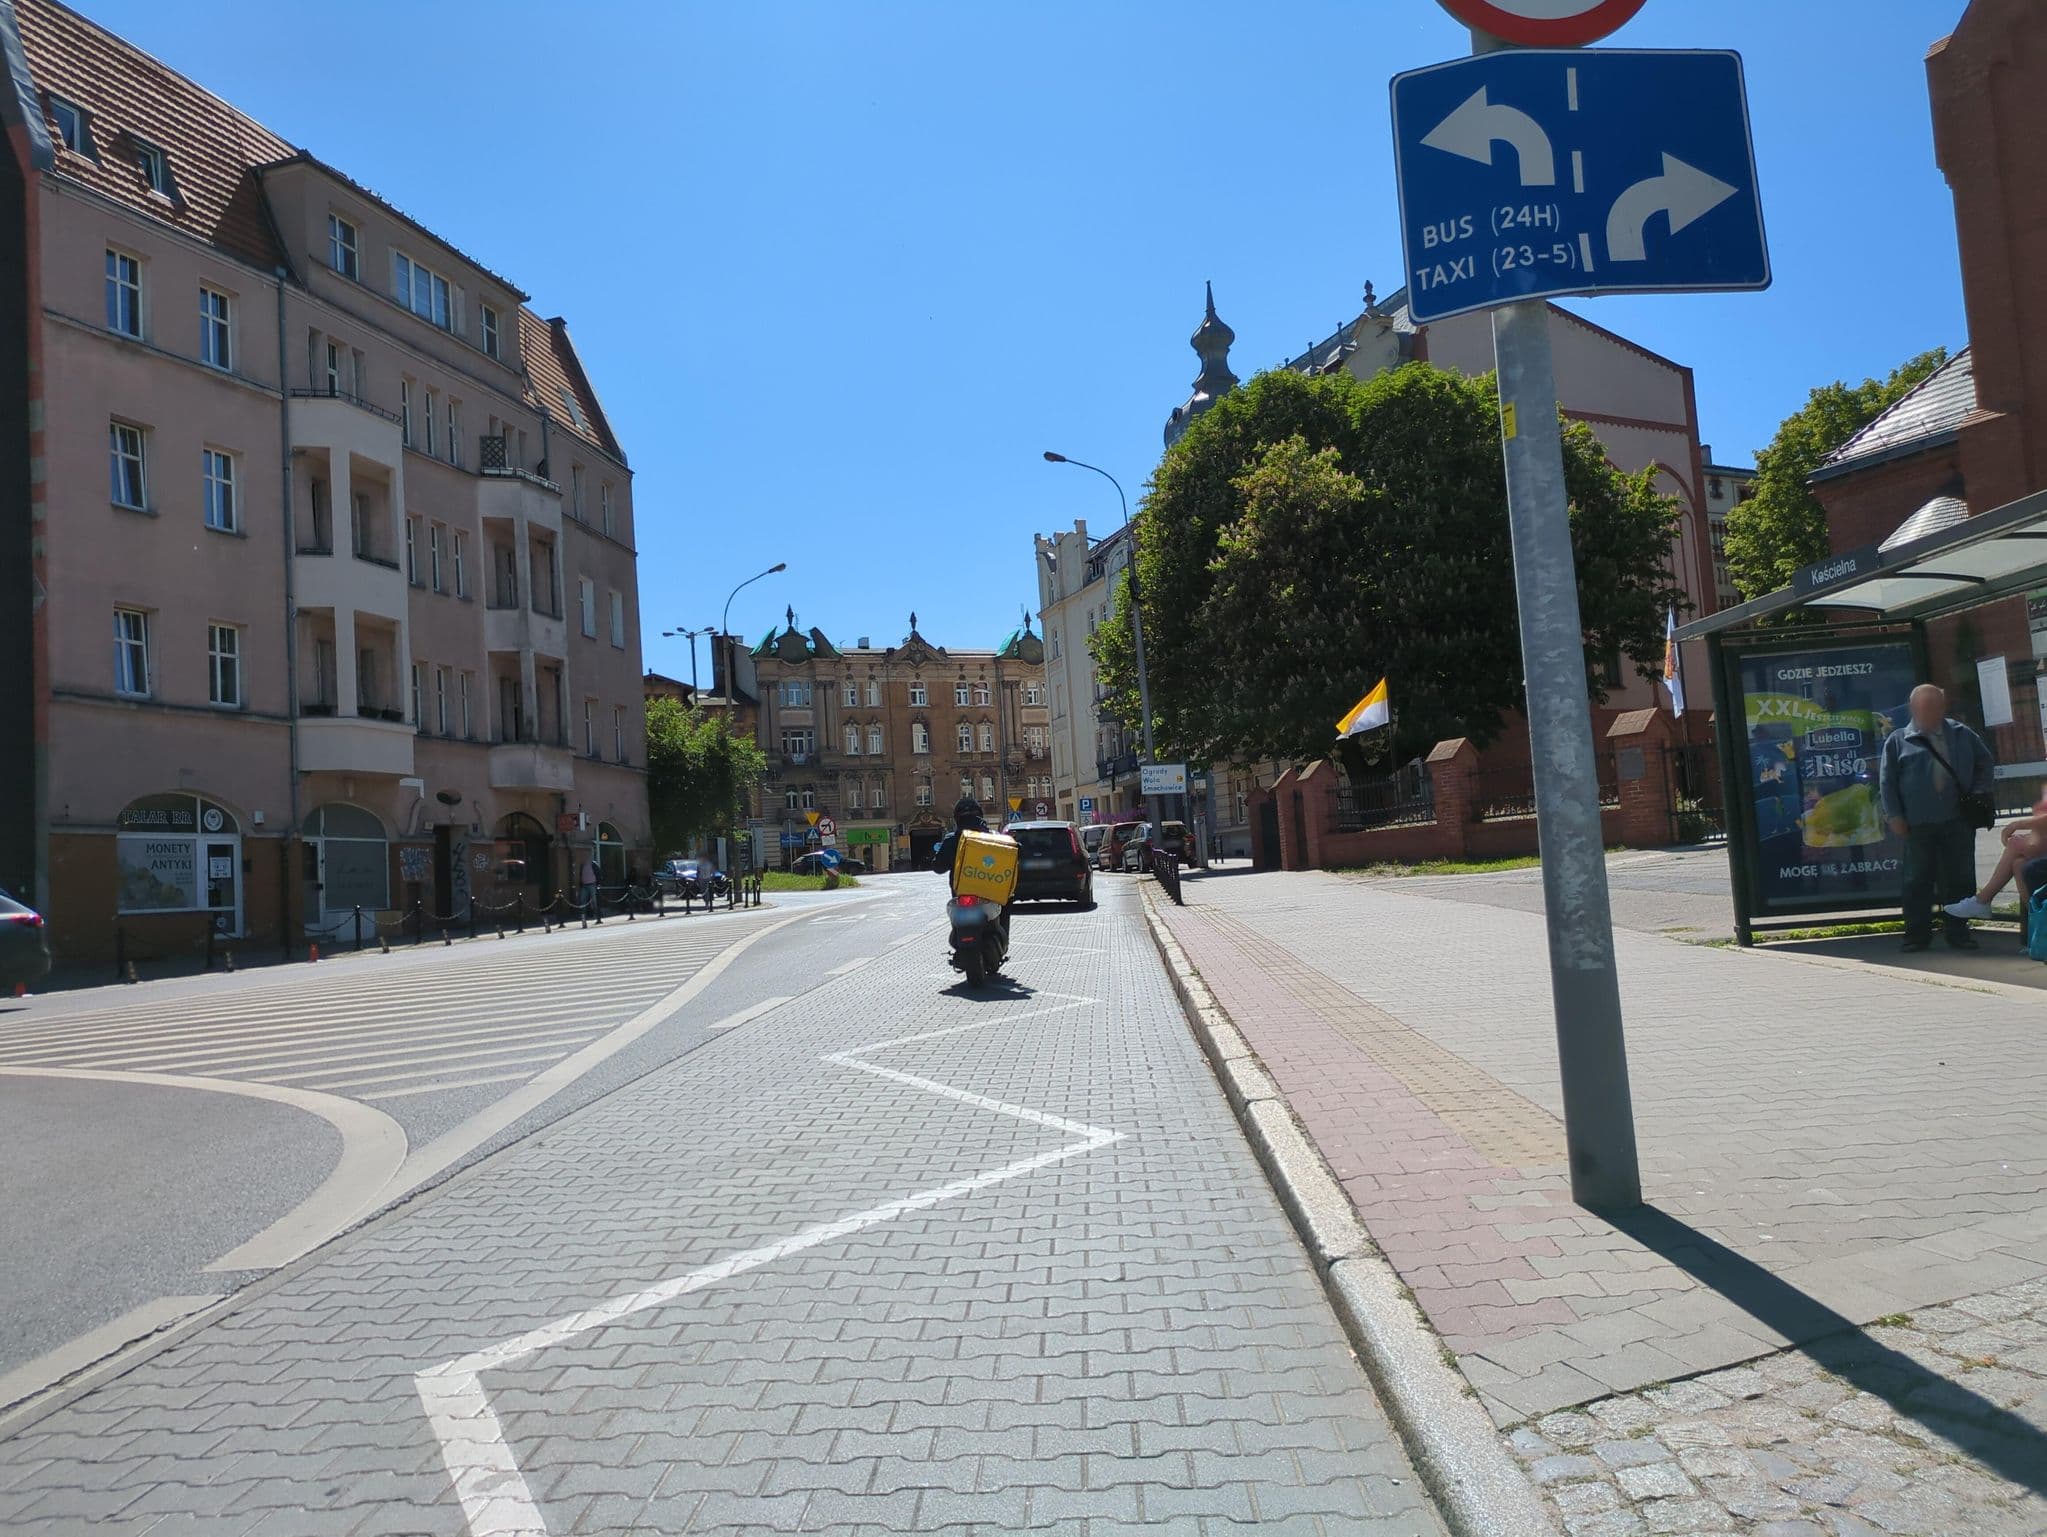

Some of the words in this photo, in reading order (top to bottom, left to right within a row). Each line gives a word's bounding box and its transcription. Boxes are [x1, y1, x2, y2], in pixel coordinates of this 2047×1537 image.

[1423, 215, 1474, 249] BUS
[1491, 203, 1560, 237] (24H)
[1416, 256, 1475, 291] TAXI
[1492, 242, 1576, 278] (23-5)
[1811, 560, 1857, 586] Kościelna
[1777, 667, 1813, 680] GDZIE
[1815, 663, 1873, 678] JEDZIESZ?
[1757, 699, 1803, 718] XXL
[1811, 731, 1856, 745] Lubella
[1814, 753, 1868, 778] Riso
[145, 843, 192, 855] MONETY
[151, 859, 193, 871] ANTYKI
[1779, 864, 1818, 879] MOGĘ
